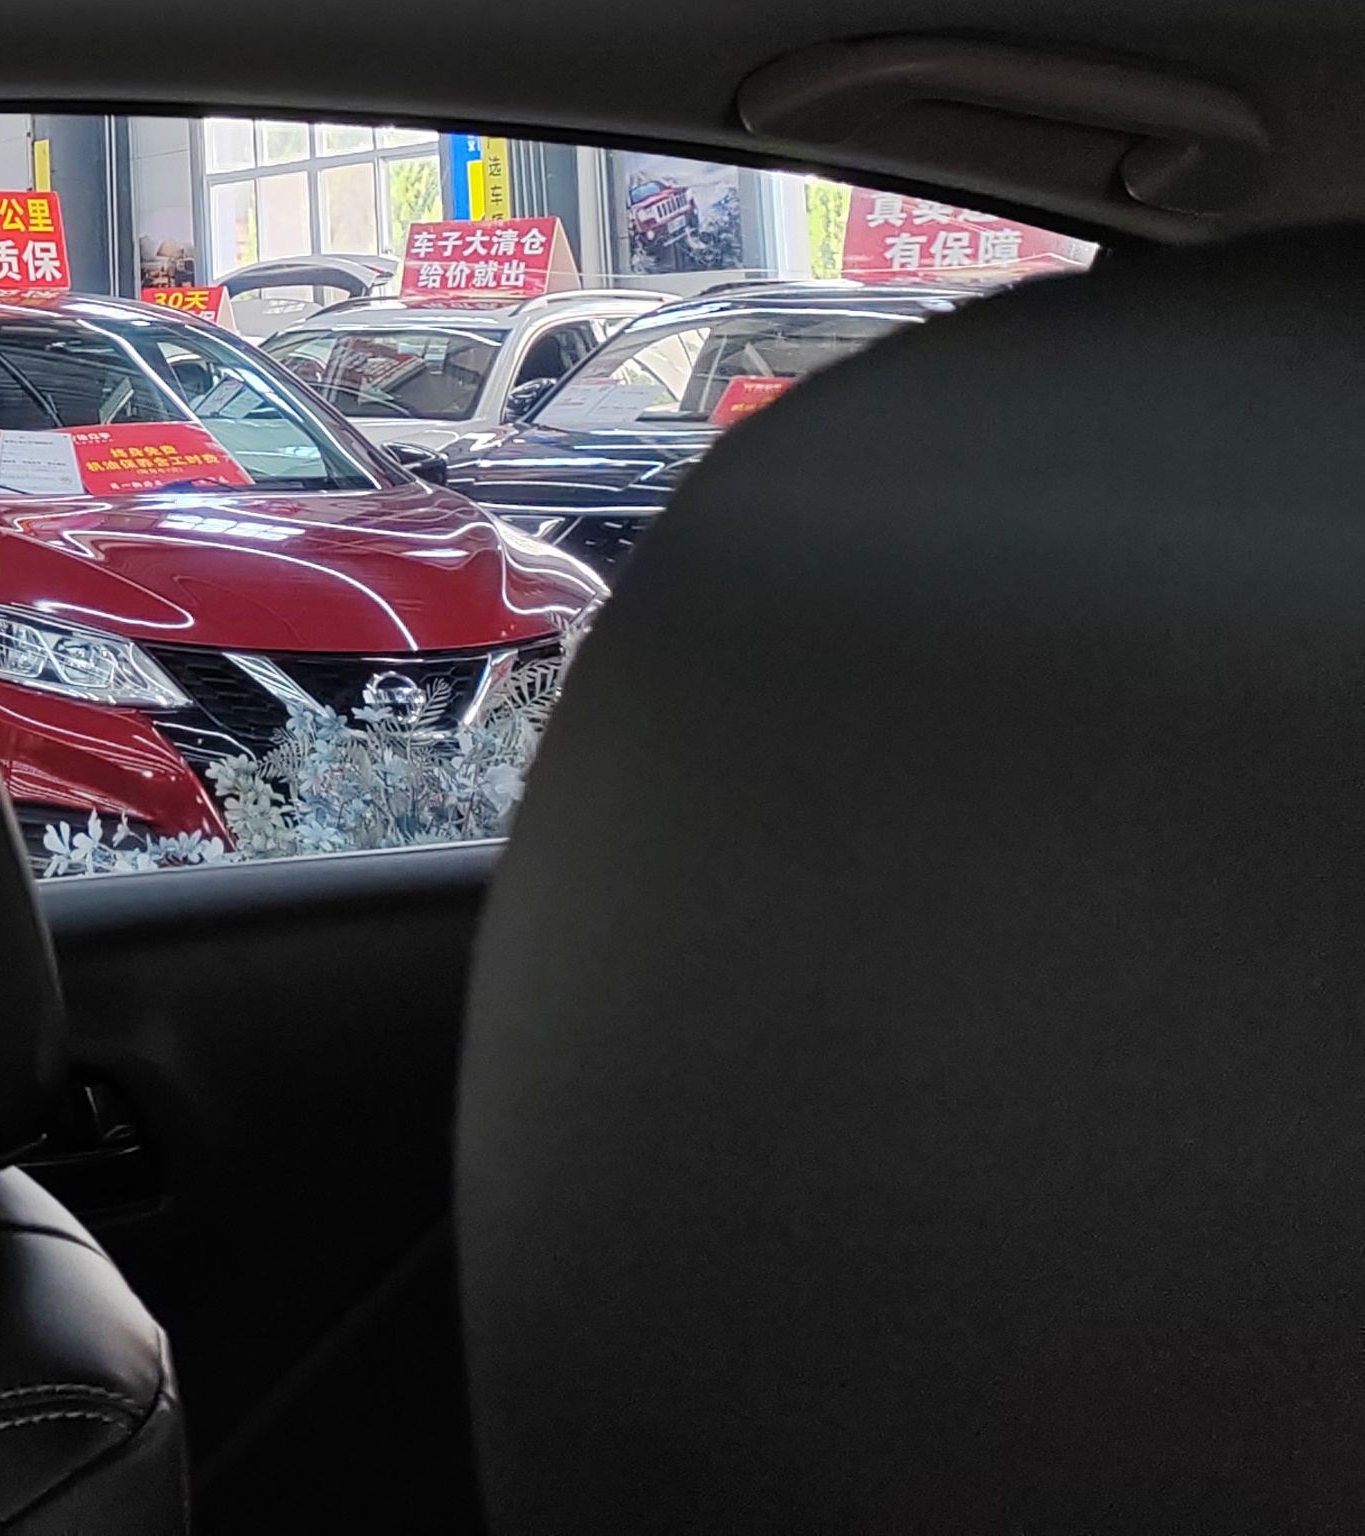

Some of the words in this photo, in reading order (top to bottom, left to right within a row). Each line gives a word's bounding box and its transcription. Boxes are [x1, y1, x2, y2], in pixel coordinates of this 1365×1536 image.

[410, 227, 547, 259] 车子大清仓
[883, 228, 1024, 271] 有保障
[417, 259, 526, 289] 给价就出
[153, 290, 210, 311] 30天
